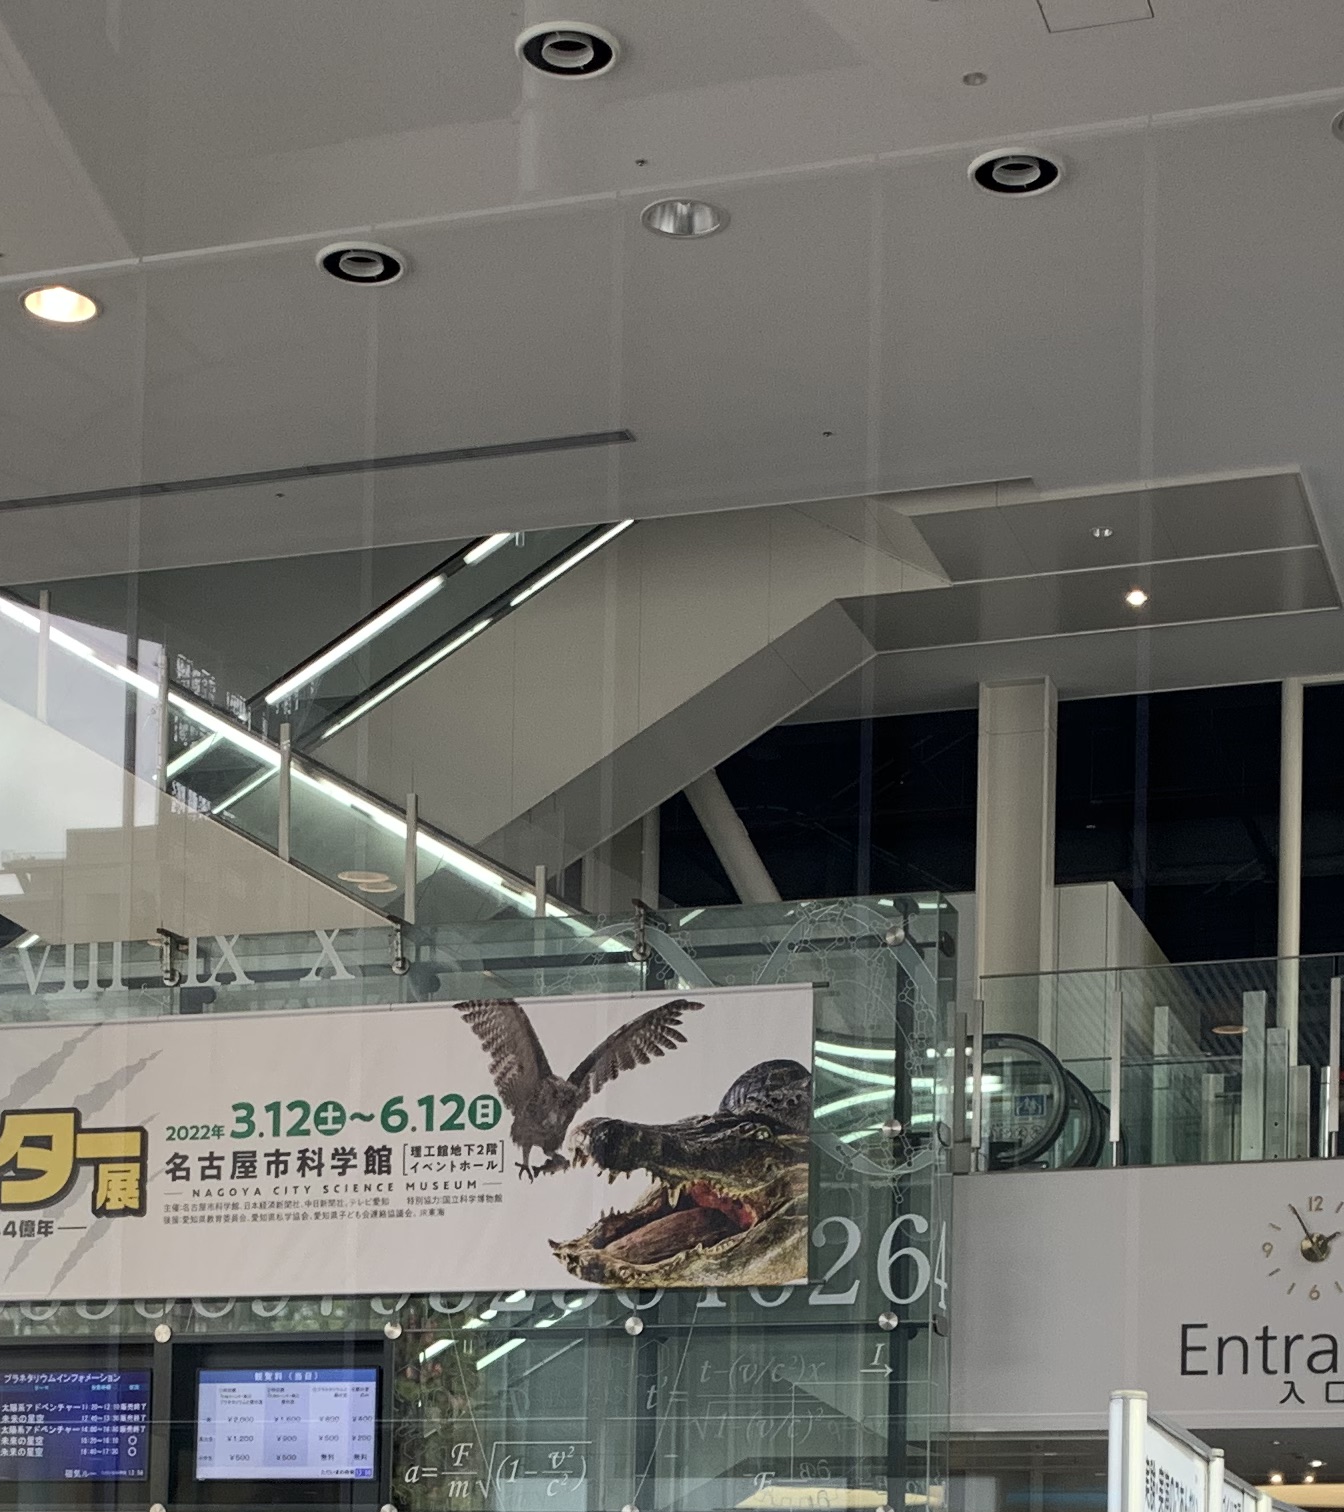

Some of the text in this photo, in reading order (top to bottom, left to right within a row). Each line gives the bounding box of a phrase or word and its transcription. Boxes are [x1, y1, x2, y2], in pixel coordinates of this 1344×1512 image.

[180, 934, 255, 988] IX
[300, 928, 355, 982] X
[165, 1124, 225, 1142] 2022年
[164, 1143, 499, 1182] 名古屋市科学館 理工館地下2階
[410, 1159, 499, 1174] イベントホール
[192, 1180, 477, 1198] NAGOYA CITY SCIENCE MUSEUM
[1308, 1196, 1323, 1212] 12
[1262, 1242, 1273, 1257] 9
[1309, 1285, 1320, 1300] 6
